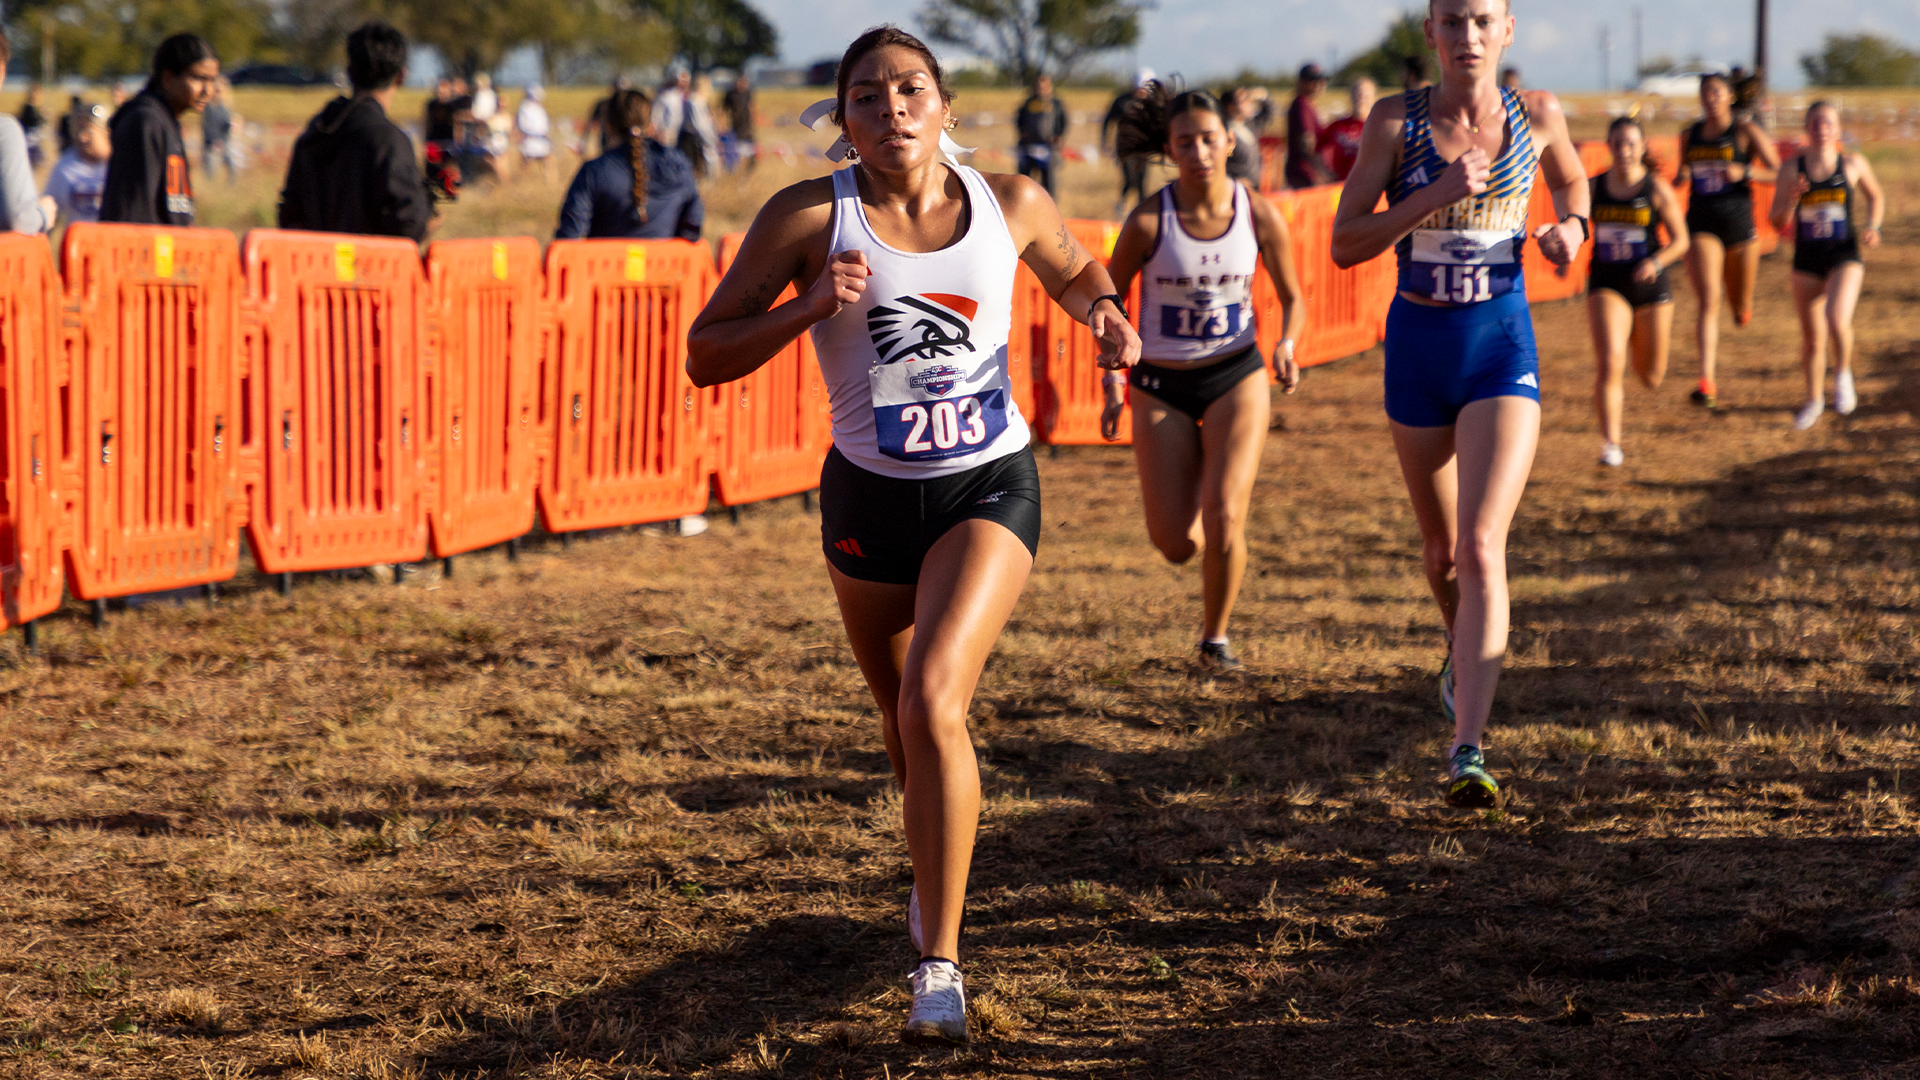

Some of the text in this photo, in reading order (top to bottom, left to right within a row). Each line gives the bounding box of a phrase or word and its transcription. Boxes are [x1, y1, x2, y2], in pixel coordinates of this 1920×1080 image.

[1421, 197, 1529, 231] AVELINAS
[1431, 265, 1493, 303] 151
[1177, 306, 1229, 336] 173
[912, 373, 965, 385] CHAMPIONSHIPS
[901, 396, 986, 454] 203
